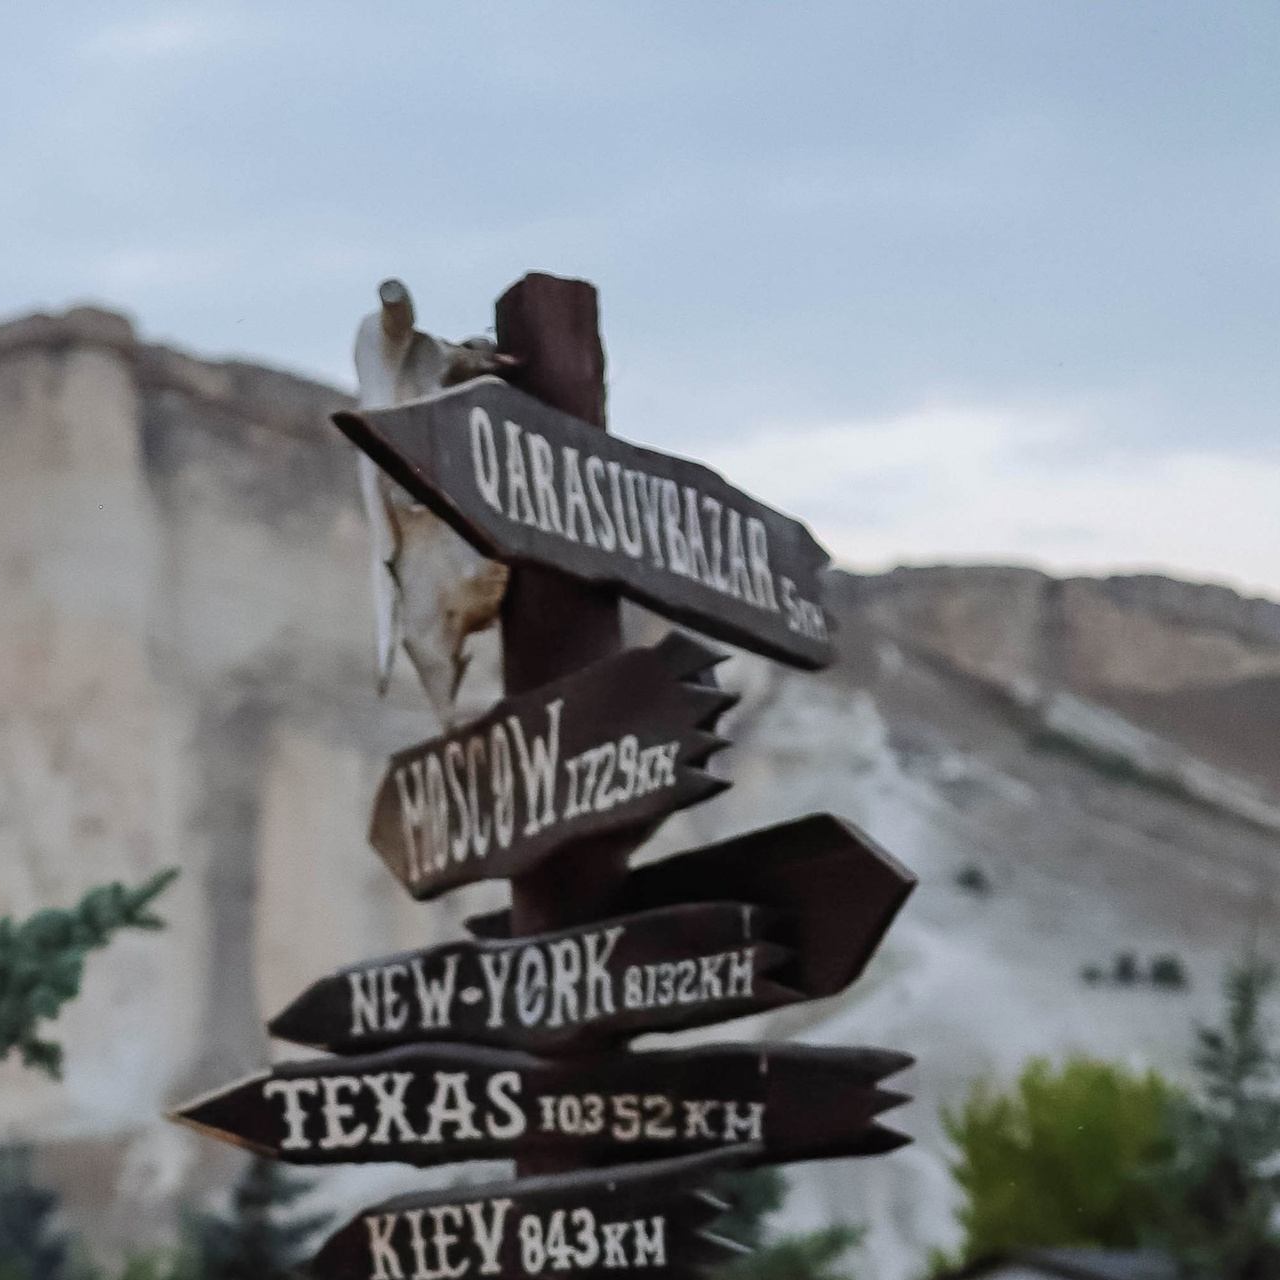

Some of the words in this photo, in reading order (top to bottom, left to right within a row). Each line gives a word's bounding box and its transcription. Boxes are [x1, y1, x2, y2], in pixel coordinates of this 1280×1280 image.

[396, 699, 564, 881] MOSCOW
[349, 927, 625, 1035] NEW-YORK
[264, 1071, 527, 1150] TEXAS
